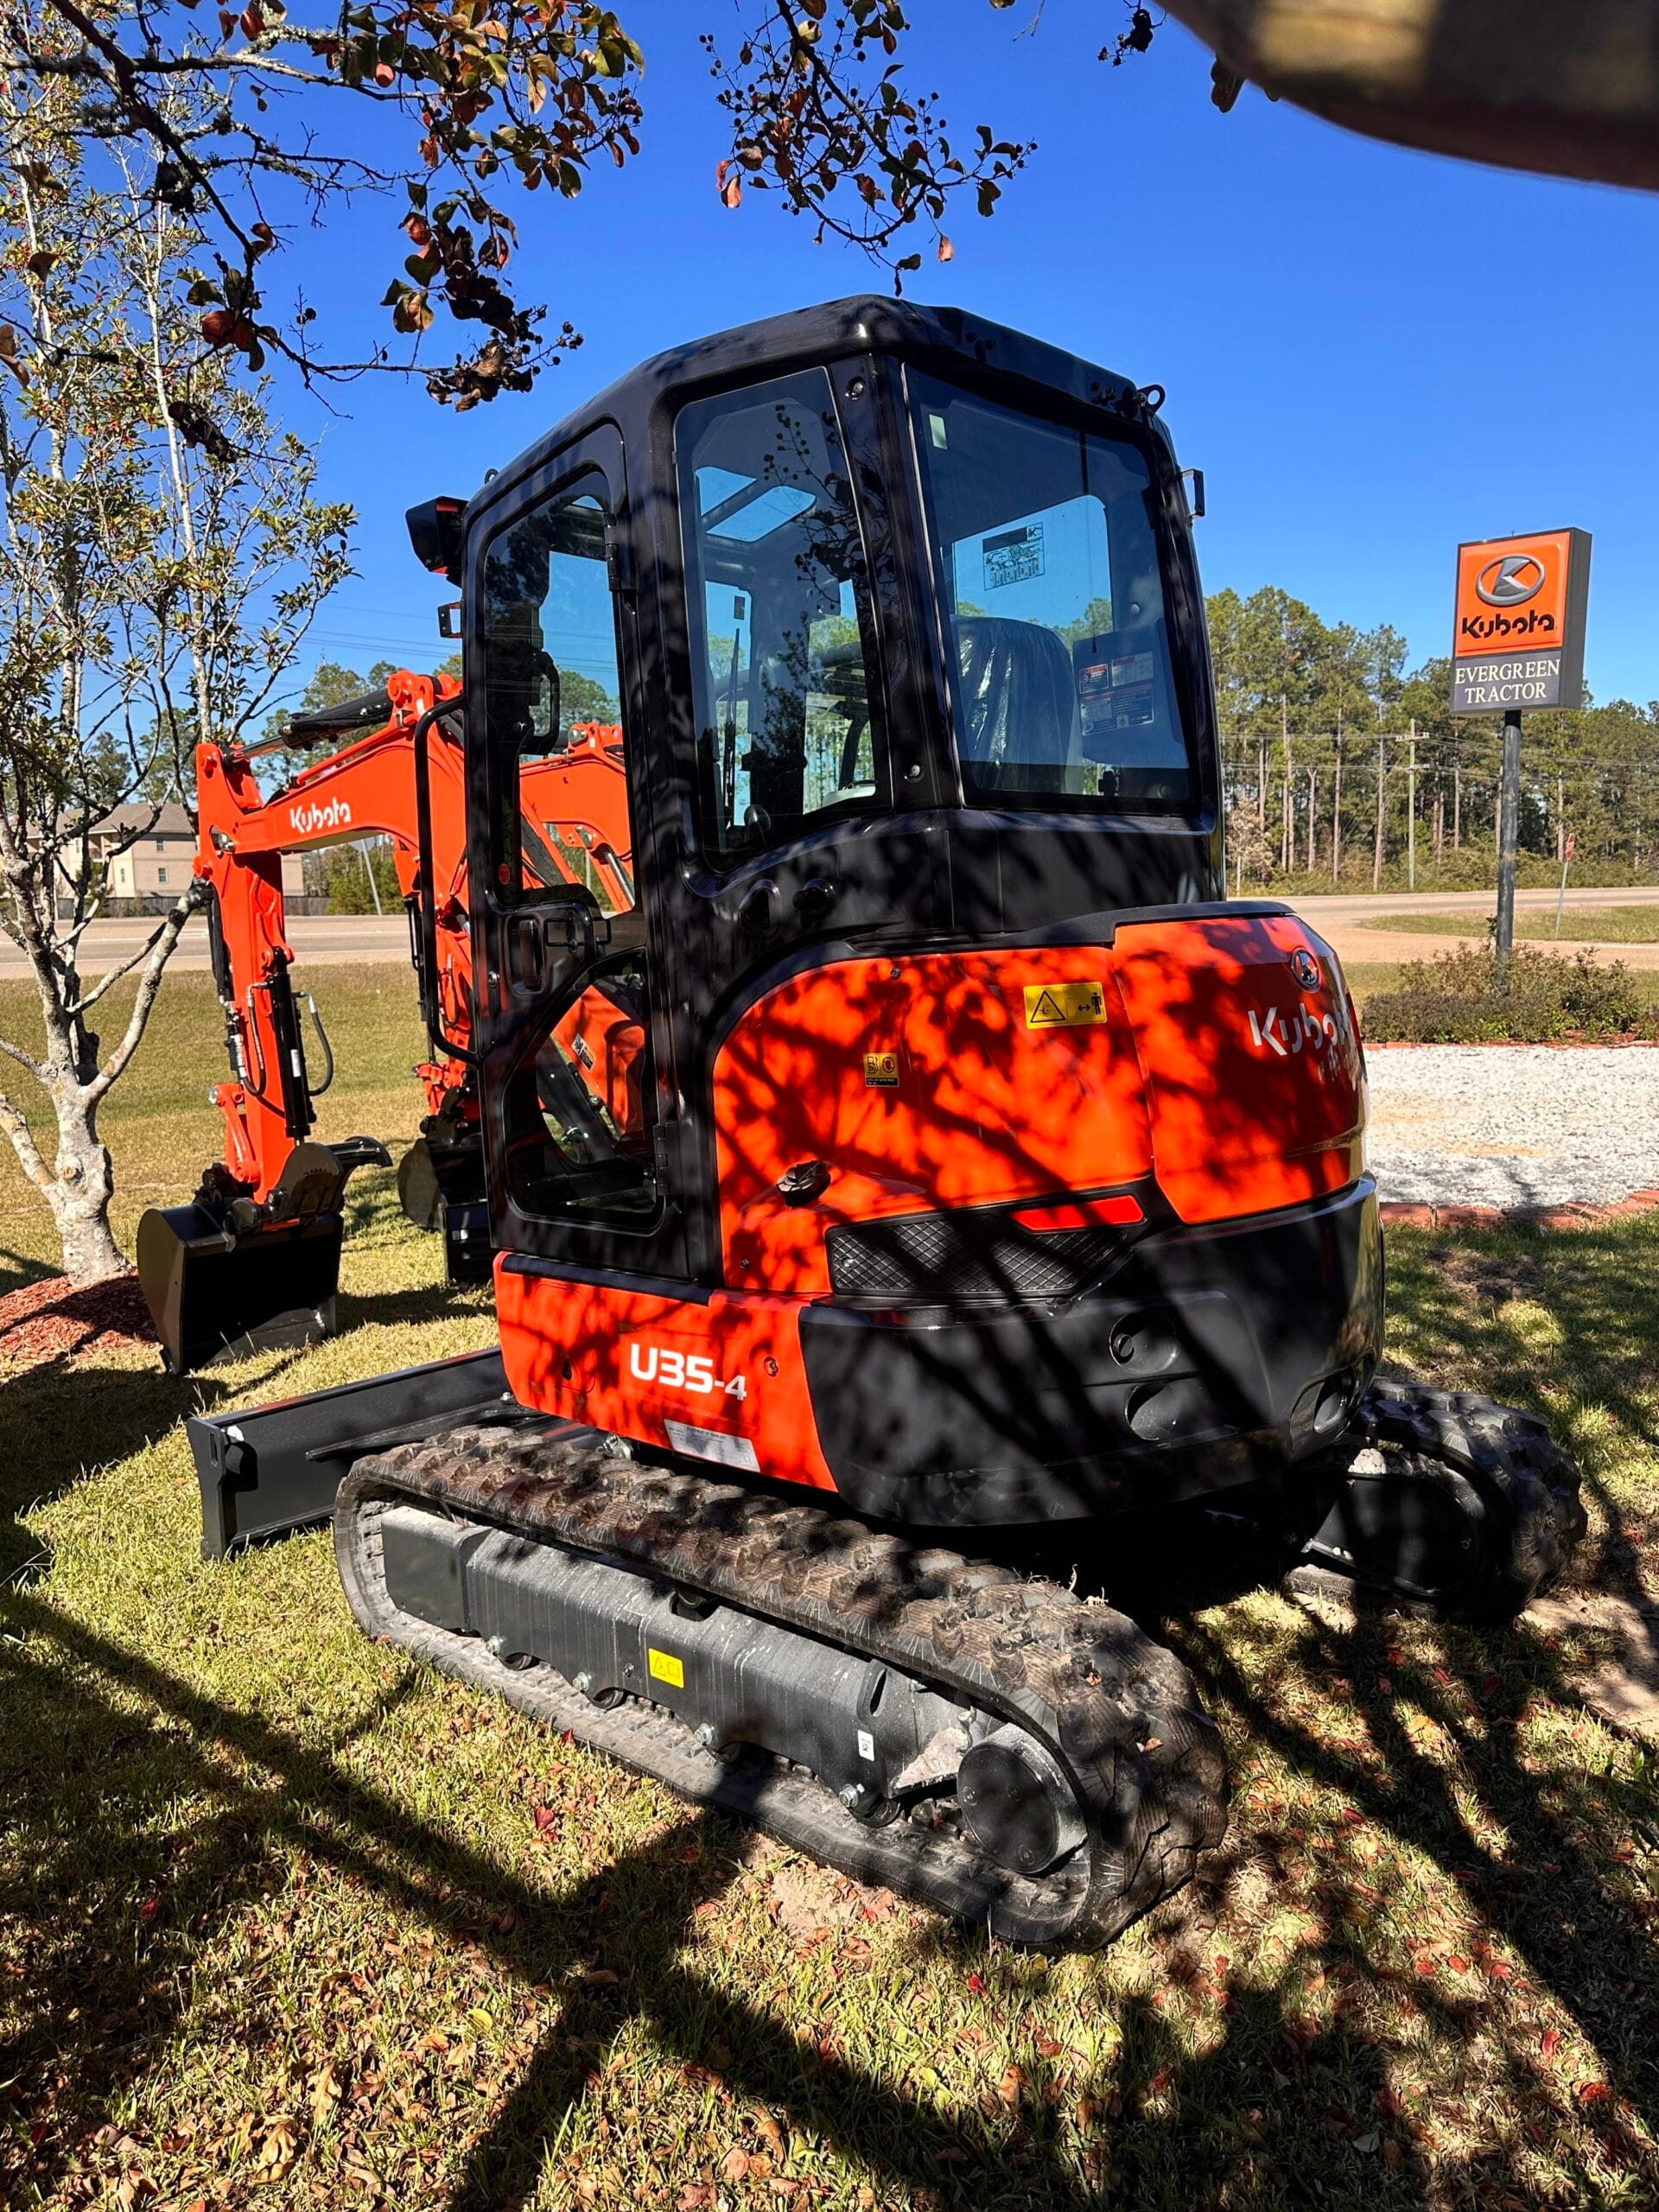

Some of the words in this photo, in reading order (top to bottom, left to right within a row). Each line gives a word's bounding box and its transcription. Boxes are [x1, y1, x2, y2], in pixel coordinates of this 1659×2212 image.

[1461, 609, 1554, 639] Kubota
[1454, 659, 1561, 684] EVERGREEN
[1465, 682, 1548, 704] TRACTOR
[289, 796, 352, 834] Kubota
[630, 1343, 747, 1402] U35-4
